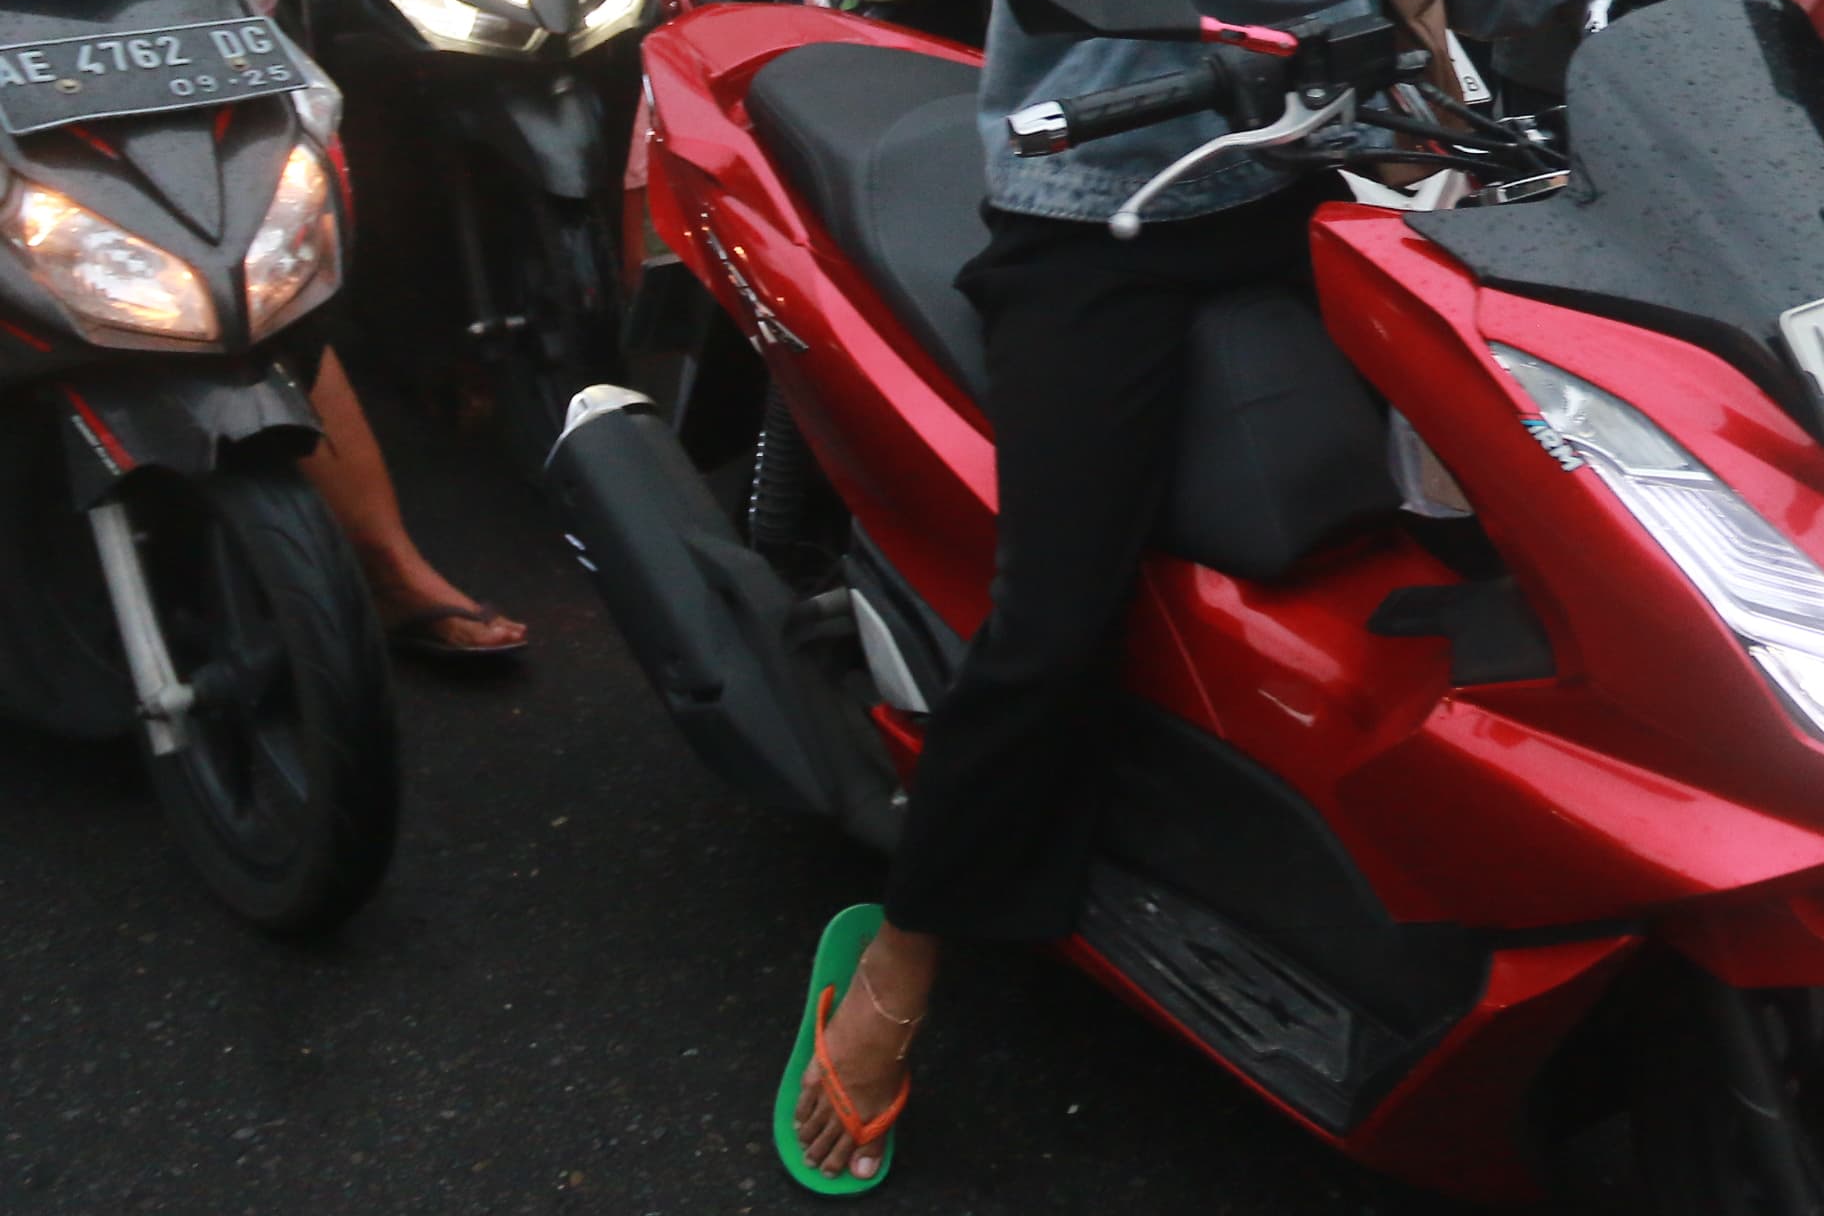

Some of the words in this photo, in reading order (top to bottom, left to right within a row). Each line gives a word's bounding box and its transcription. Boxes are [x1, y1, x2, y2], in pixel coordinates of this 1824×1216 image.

[0, 50, 58, 85] AE
[75, 35, 193, 76] 4762
[209, 25, 274, 60] DG
